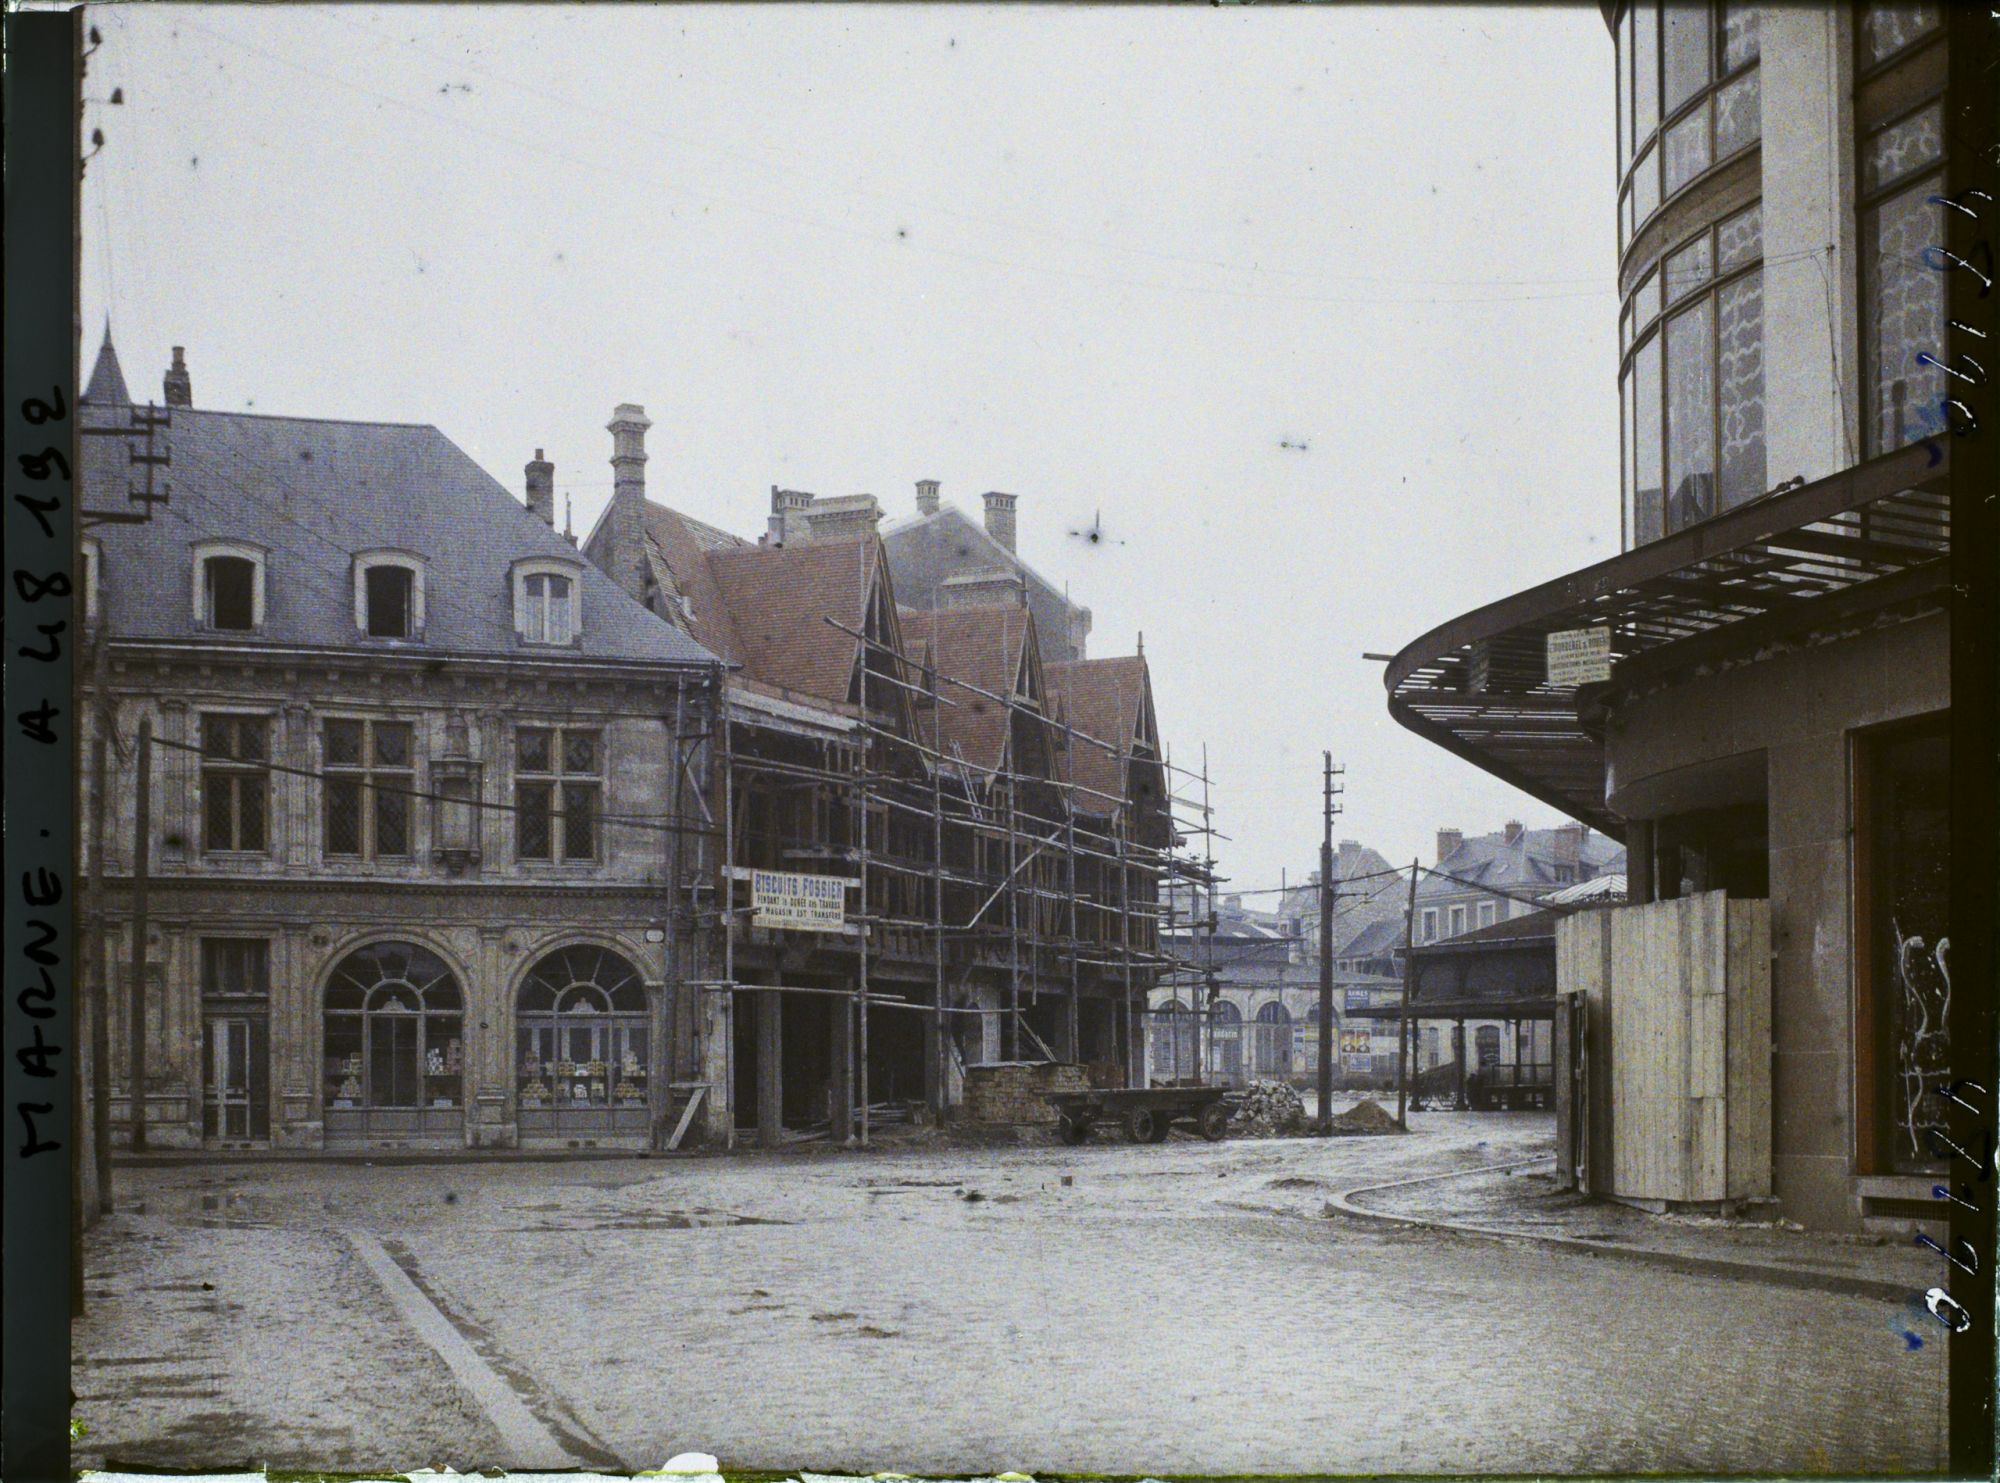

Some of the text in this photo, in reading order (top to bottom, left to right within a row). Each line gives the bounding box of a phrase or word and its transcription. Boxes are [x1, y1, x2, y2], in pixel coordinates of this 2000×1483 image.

[13, 570, 71, 662] 48
[17, 698, 60, 744] A
[756, 873, 842, 898] BISCUITS FOSSIER
[757, 895, 779, 905] PENDANT
[765, 907, 792, 916] MAGASIN
[797, 910, 807, 918] EST
